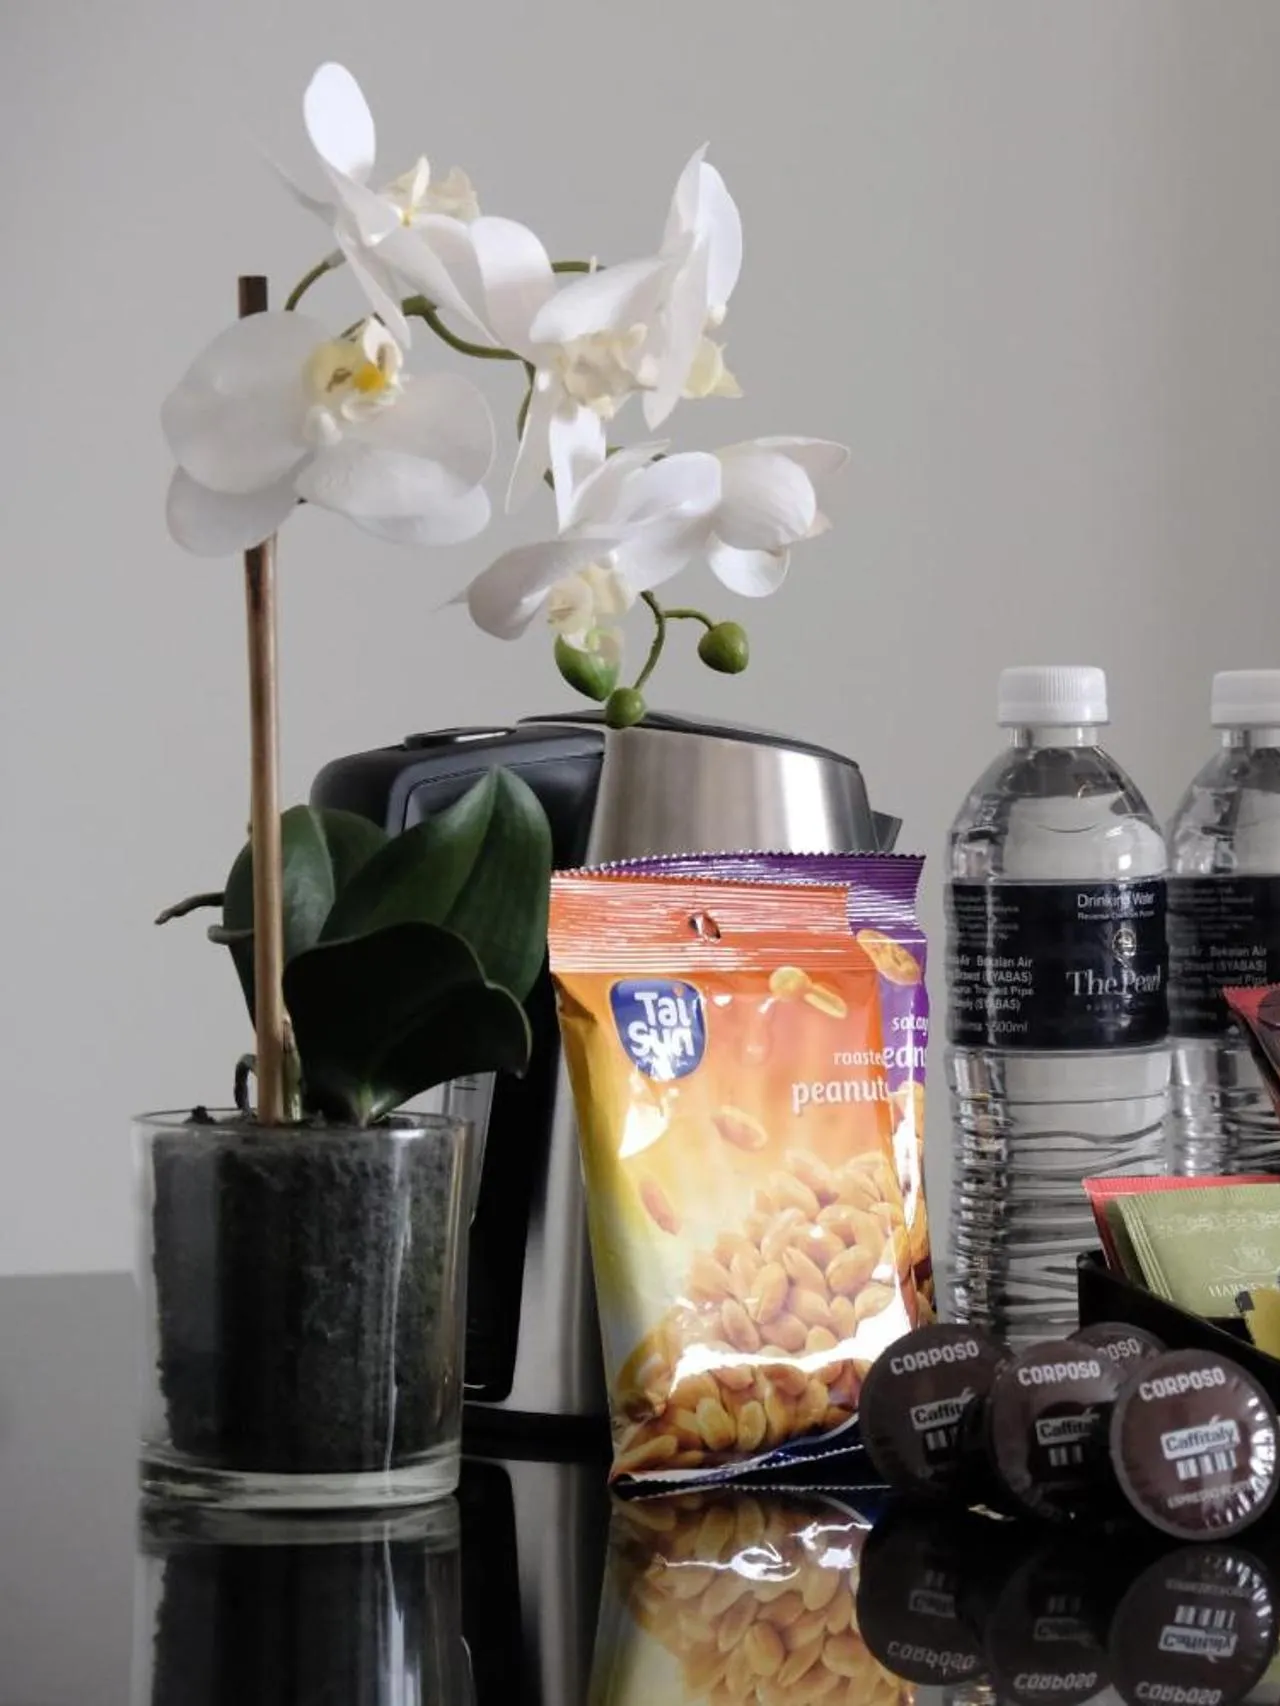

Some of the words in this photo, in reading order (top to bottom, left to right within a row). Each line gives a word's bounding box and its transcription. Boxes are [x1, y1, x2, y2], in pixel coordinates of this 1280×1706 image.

[1065, 967, 1119, 996] The
[634, 984, 692, 1027] Tai
[889, 1340, 980, 1376] CORPOSO
[1018, 1360, 1100, 1387] CORPOSO
[1138, 1366, 1227, 1402] CORPOSO
[1165, 1426, 1235, 1452] Caffitaly
